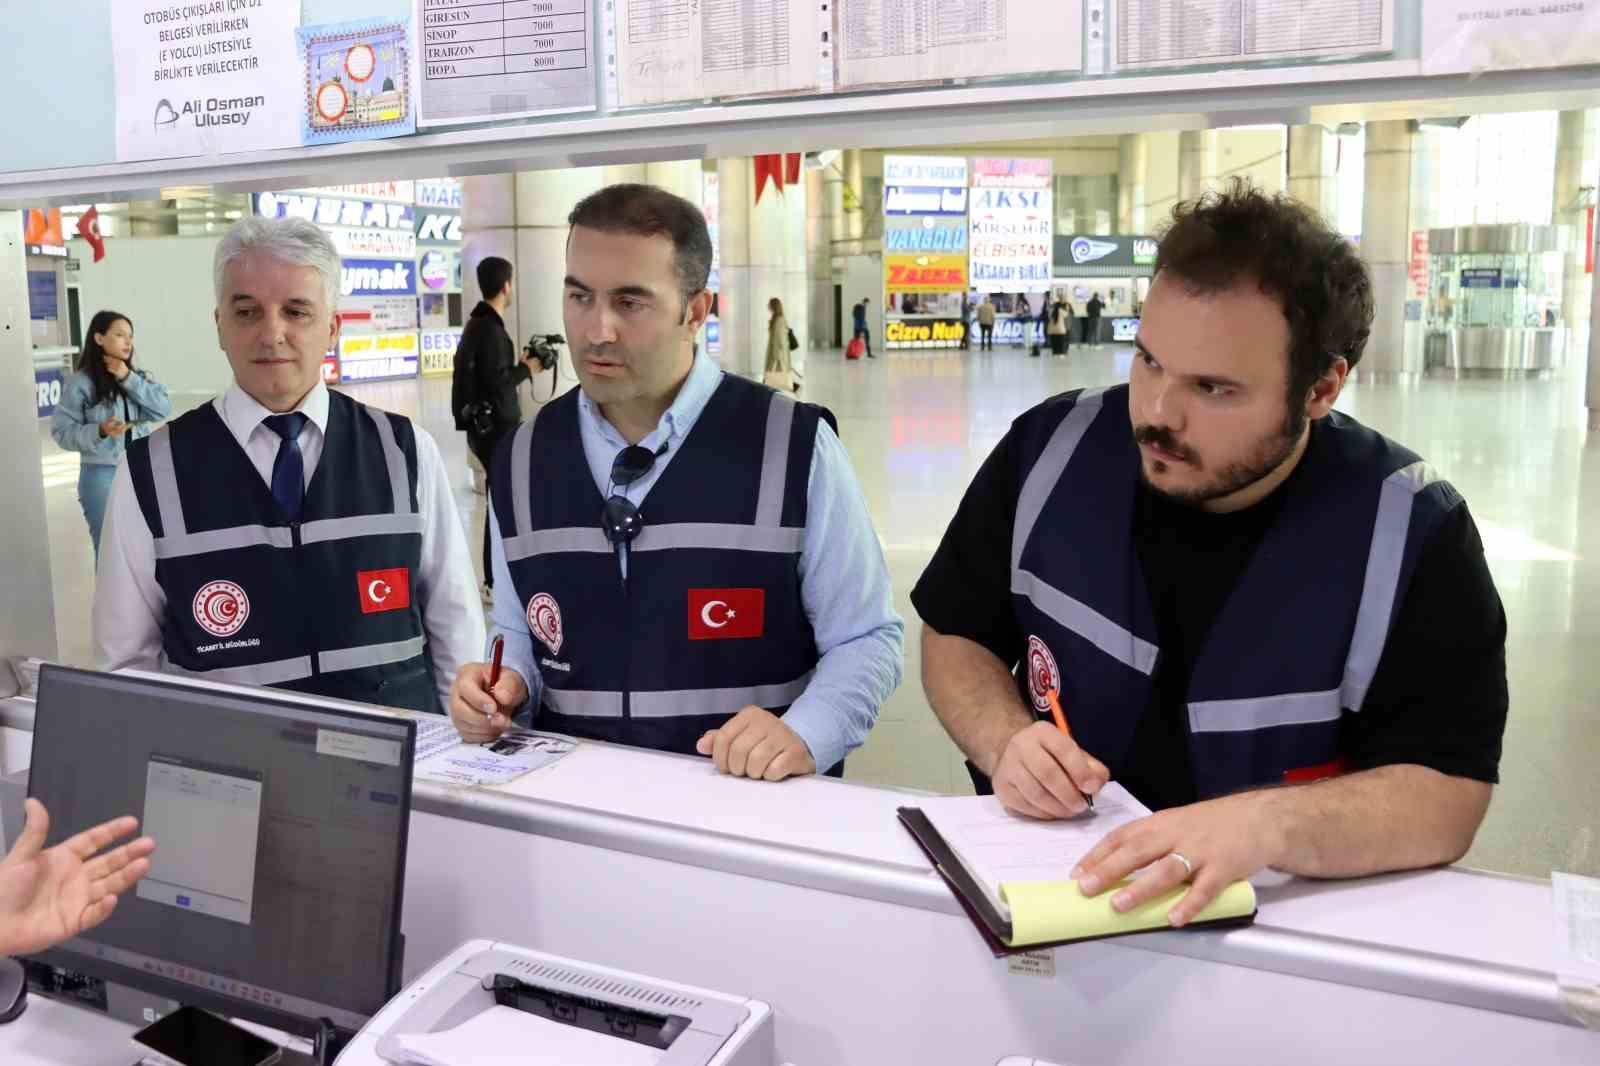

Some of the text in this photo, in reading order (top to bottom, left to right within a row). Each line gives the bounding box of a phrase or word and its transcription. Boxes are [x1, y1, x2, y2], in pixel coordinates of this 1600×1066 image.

[144, 7, 181, 25] OTOBÜS
[533, 3, 553, 13] 7000
[159, 17, 249, 42] BELGESİ VERİLİRKEN
[533, 20, 553, 31] 7000
[159, 37, 252, 64] (E YOLCU) LİSTESİYLE
[533, 38, 554, 49] 7000
[428, 46, 475, 58] TRABZON
[154, 56, 259, 81] BİRLİKTE VERİLECEKTİR
[534, 56, 555, 67] 8000
[428, 65, 457, 76] HOPA
[182, 95, 265, 115] Ali Osman
[195, 111, 250, 127] Ulusoy
[976, 190, 1049, 209] AKSU
